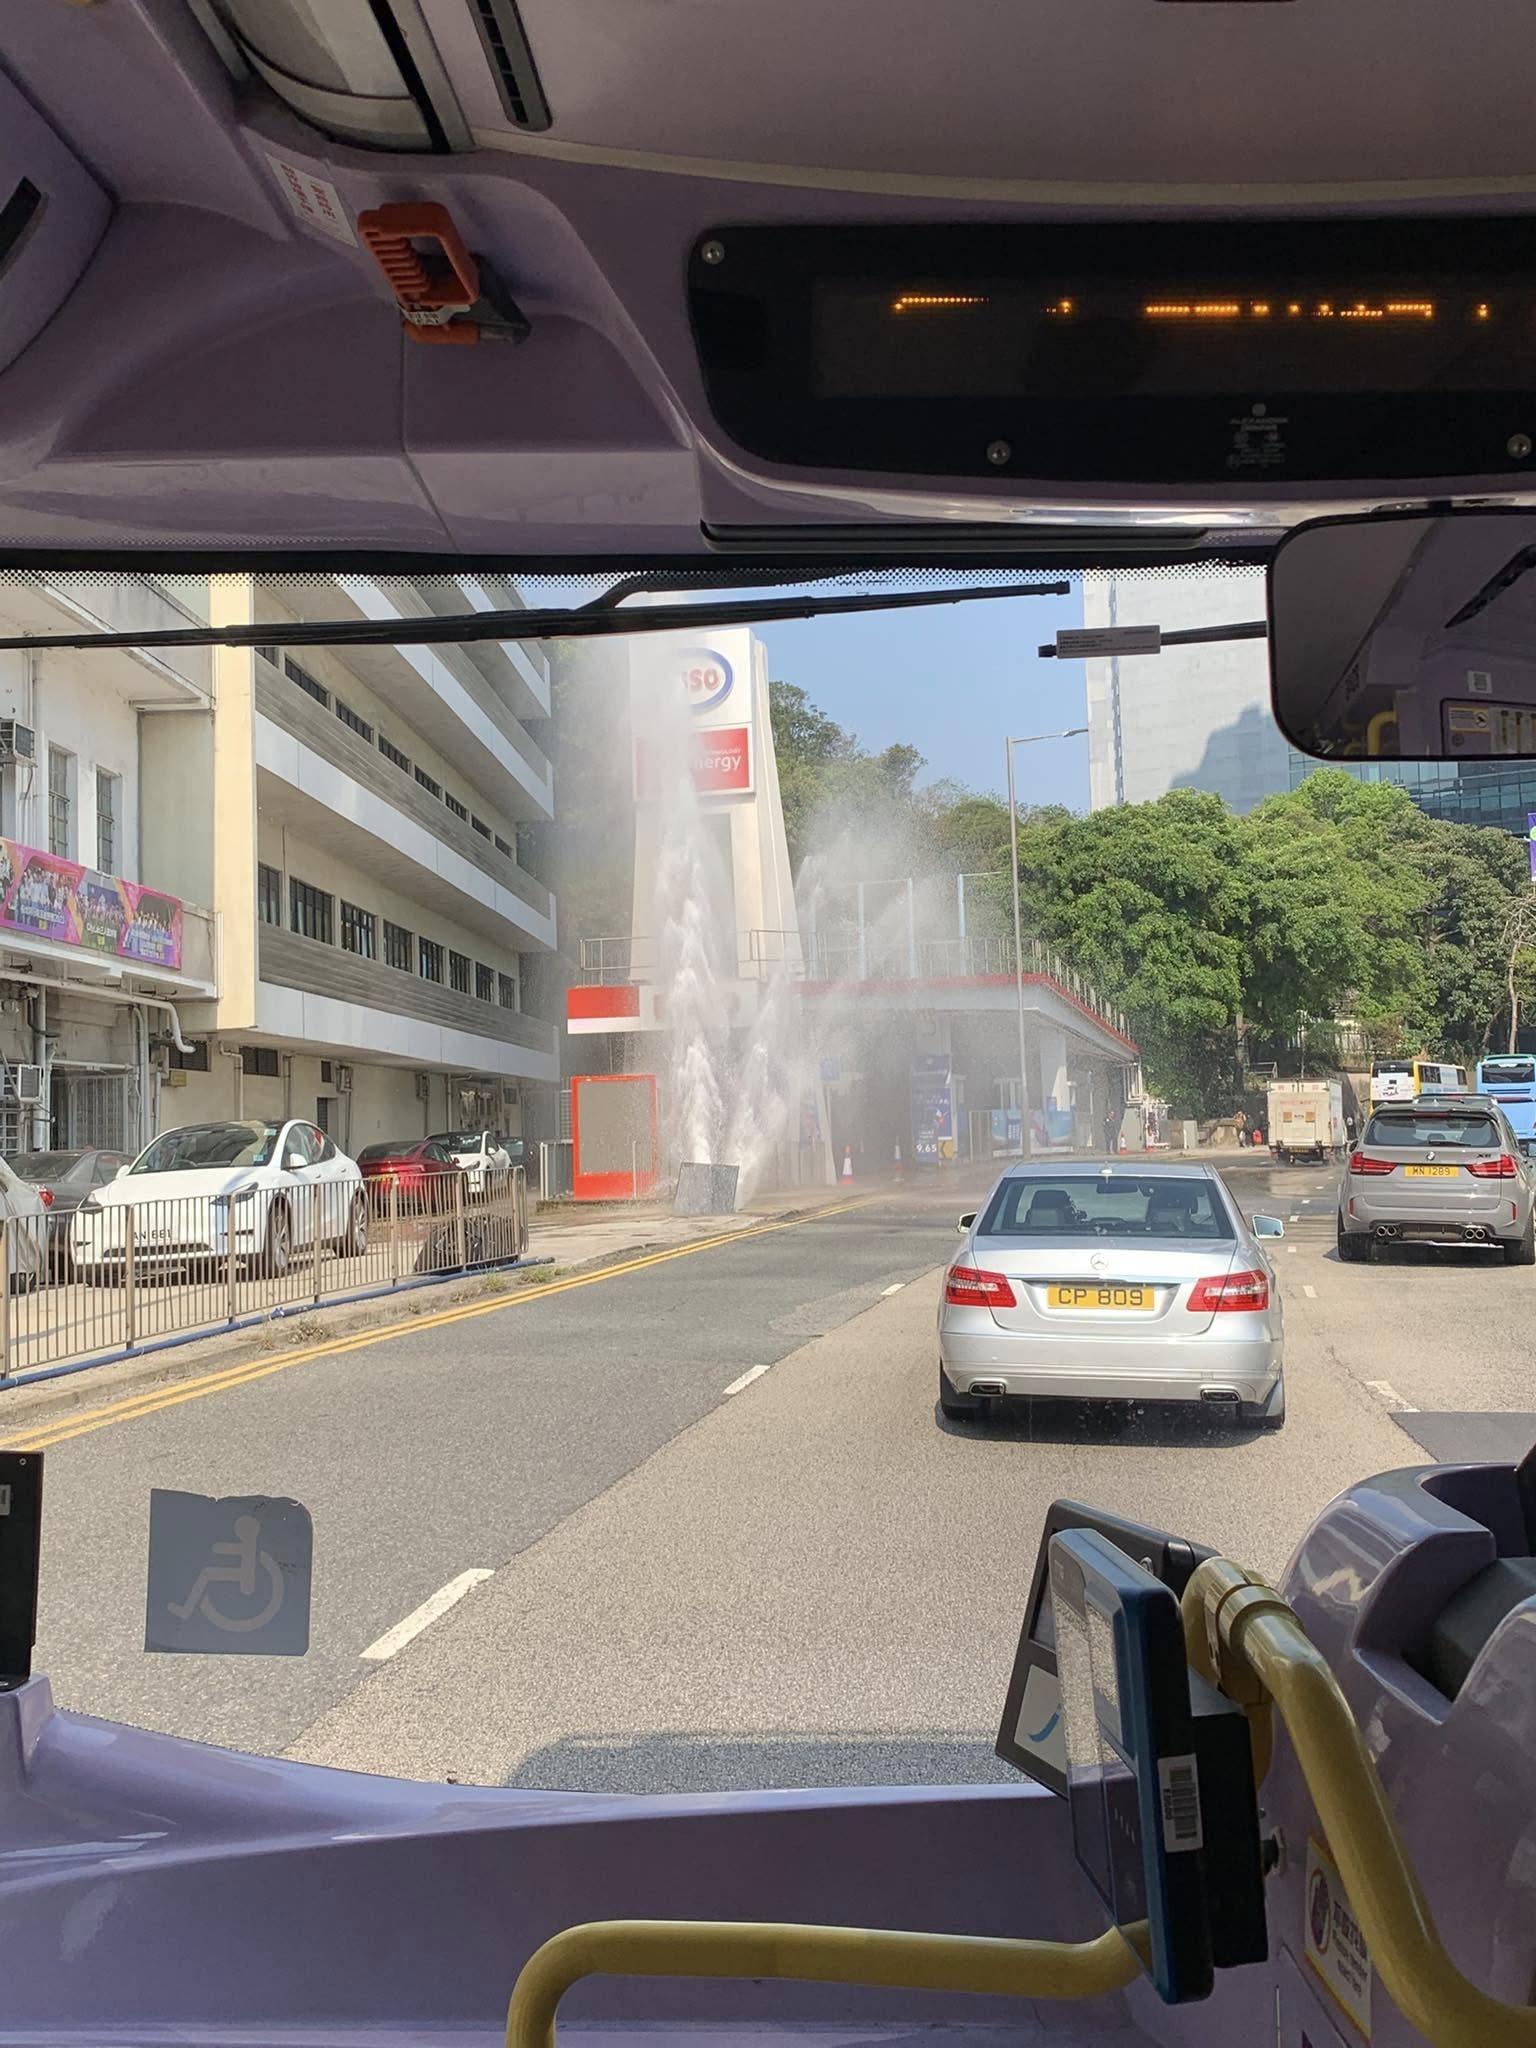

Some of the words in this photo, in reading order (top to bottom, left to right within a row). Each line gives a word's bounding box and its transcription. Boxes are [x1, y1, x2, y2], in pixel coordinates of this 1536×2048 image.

[1412, 1167, 1425, 1176] MN
[1429, 1167, 1450, 1176] 1289
[1058, 1288, 1087, 1305] CP
[1097, 1289, 1143, 1306] 809
